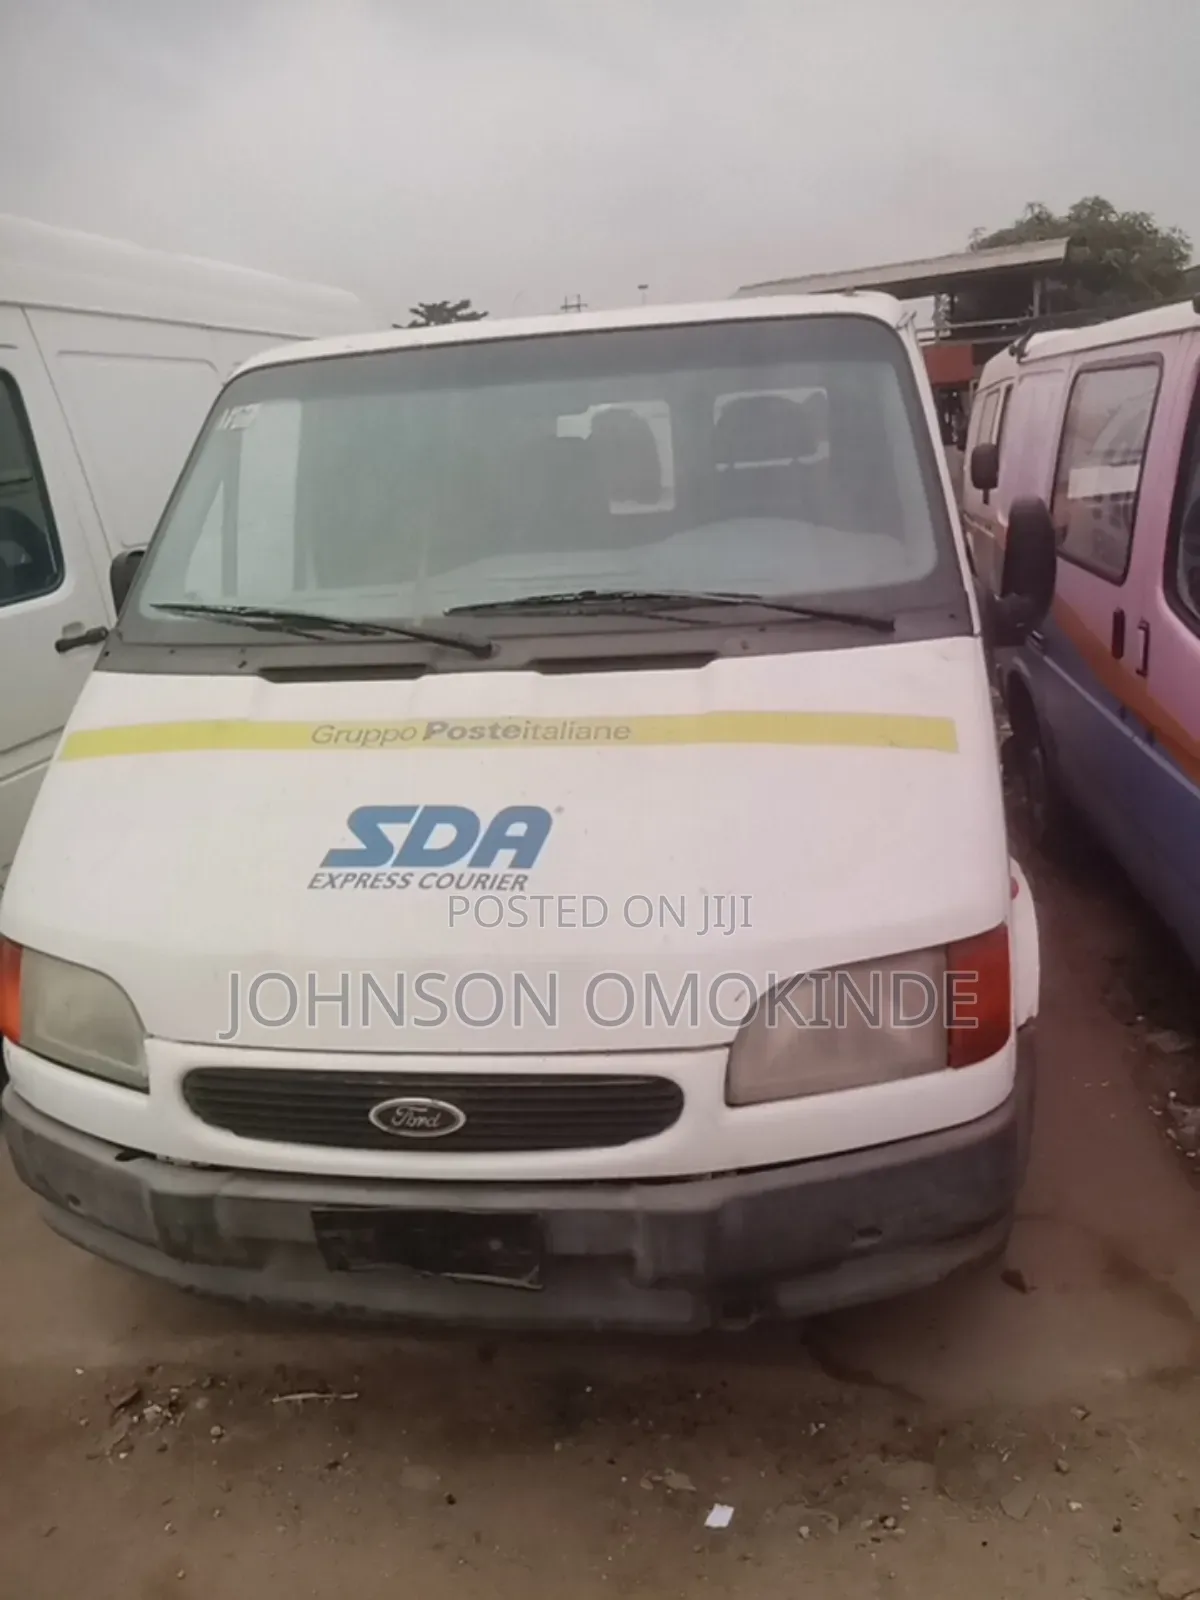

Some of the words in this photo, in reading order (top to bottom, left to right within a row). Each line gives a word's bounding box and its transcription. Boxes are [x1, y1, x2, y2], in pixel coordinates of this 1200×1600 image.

[311, 723, 417, 748] Gruppo
[319, 805, 554, 868] SDA
[307, 871, 411, 890] EXPRESS
[417, 872, 528, 891] COURIER
[390, 1105, 440, 1130] Ford
